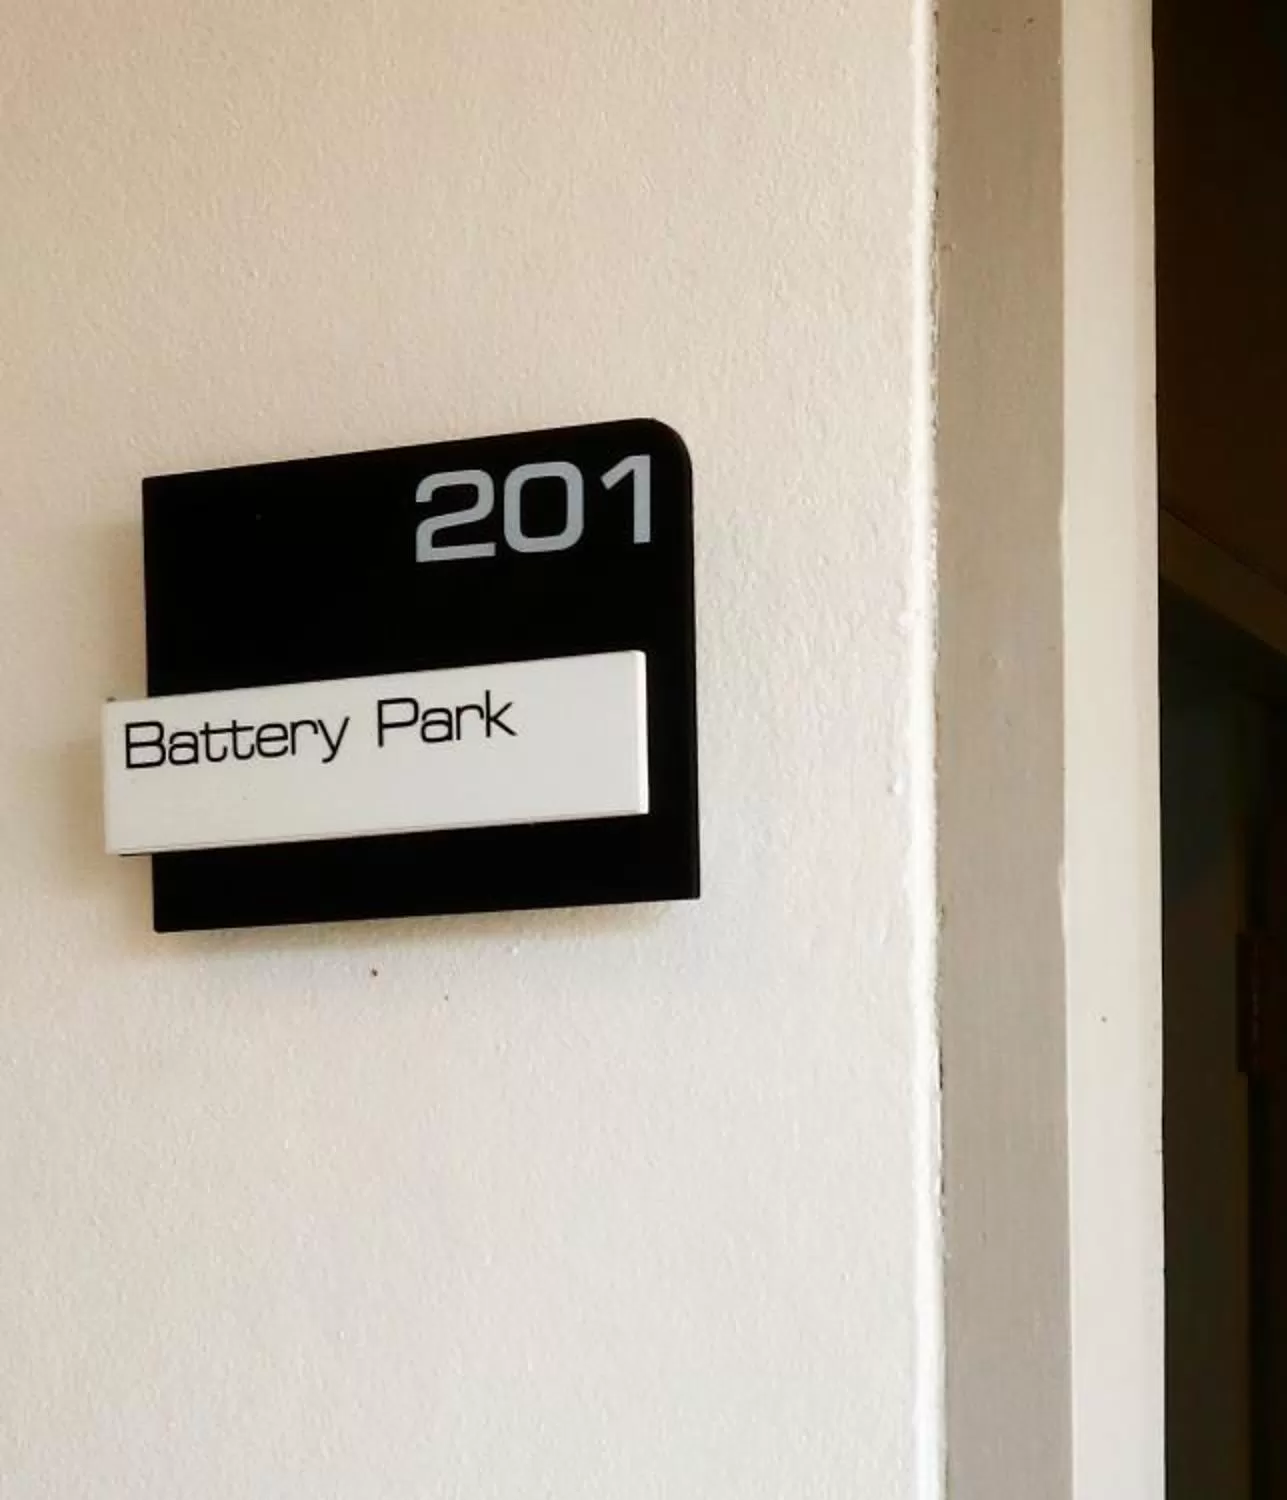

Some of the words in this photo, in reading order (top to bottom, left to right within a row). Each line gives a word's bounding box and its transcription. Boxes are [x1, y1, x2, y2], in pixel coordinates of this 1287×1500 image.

[415, 454, 651, 563] 201
[124, 716, 350, 769] Battery
[377, 690, 517, 746] Park
